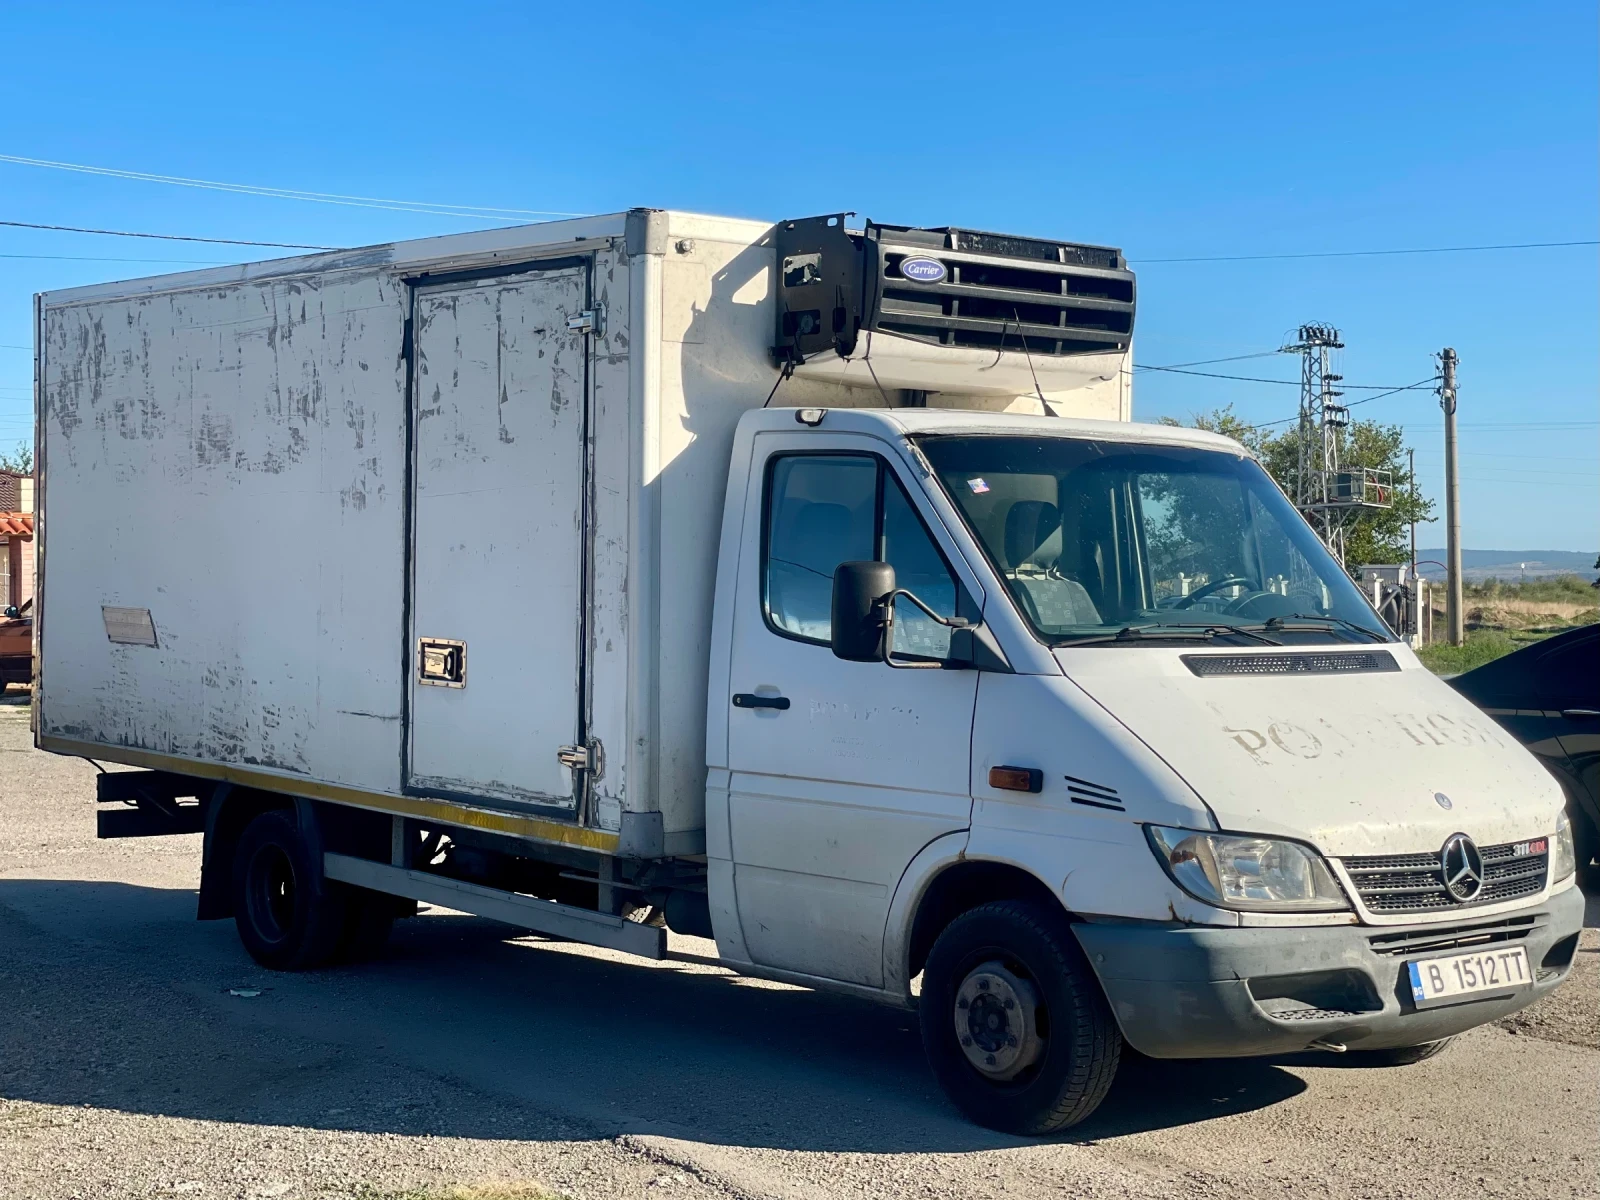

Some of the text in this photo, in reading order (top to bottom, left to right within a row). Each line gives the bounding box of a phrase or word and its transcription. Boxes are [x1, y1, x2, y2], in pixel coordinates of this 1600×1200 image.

[908, 263, 939, 275] Carrier
[1427, 963, 1445, 994] B
[1413, 986, 1424, 997] BG
